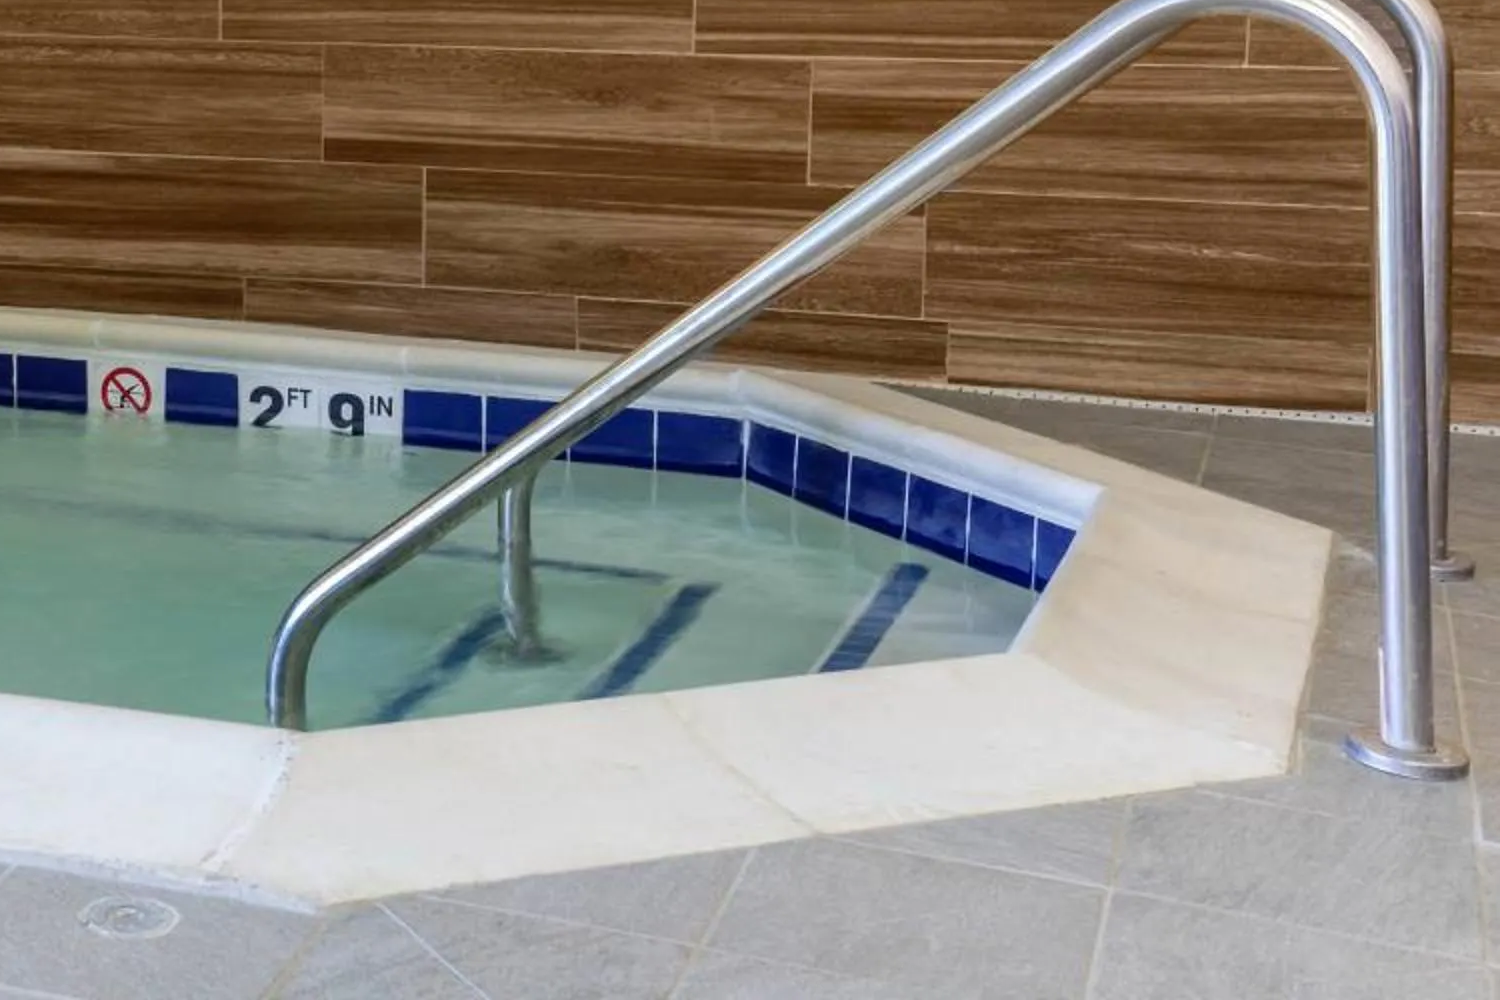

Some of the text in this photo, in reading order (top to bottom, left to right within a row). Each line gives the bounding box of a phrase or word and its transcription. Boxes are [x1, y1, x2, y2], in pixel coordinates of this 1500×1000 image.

[249, 386, 394, 436] 2 FT 9 IN
